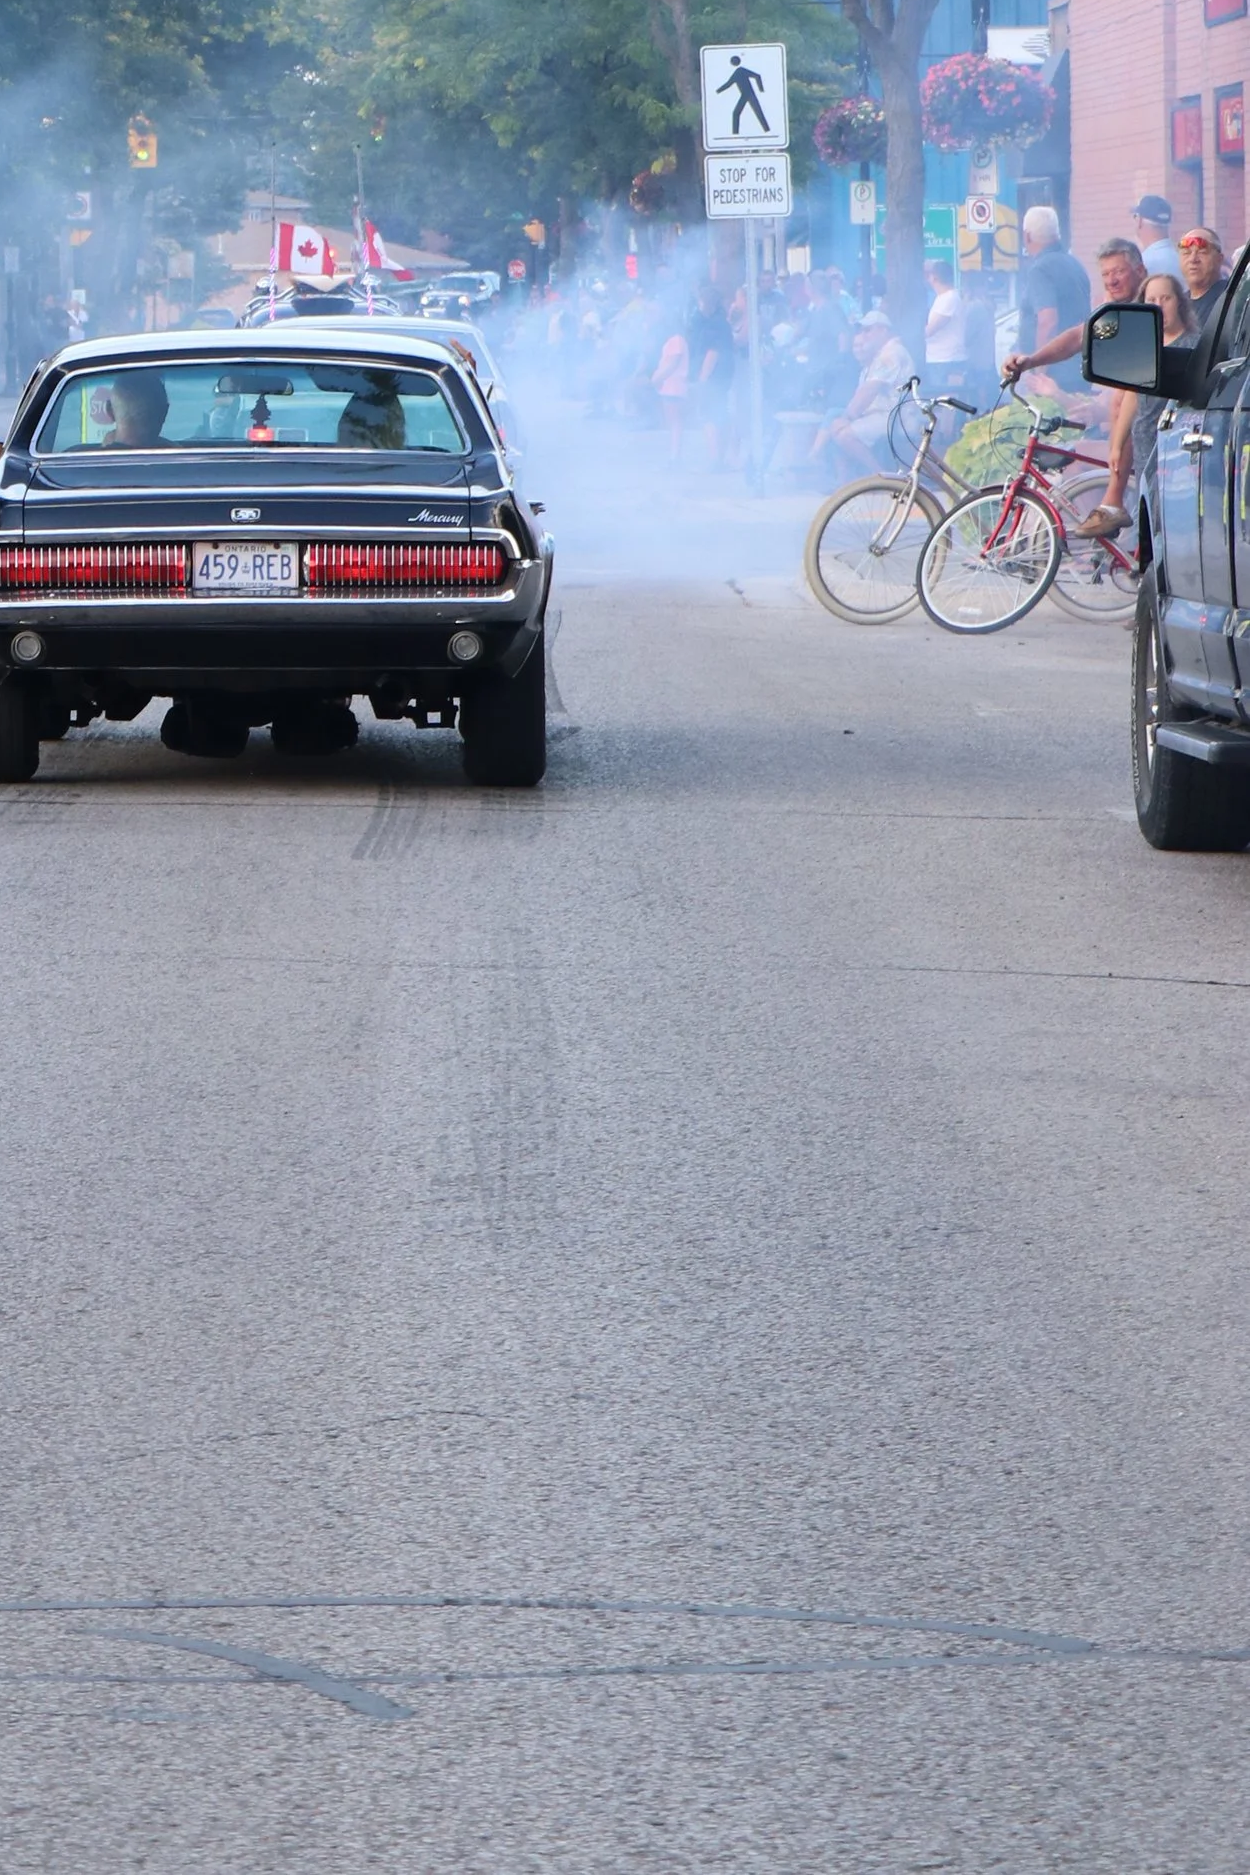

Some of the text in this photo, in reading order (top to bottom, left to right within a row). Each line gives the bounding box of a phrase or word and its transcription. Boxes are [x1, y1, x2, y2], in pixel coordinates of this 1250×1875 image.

[719, 167, 776, 183] STOP FOR
[713, 187, 784, 205] PEDESTRIANS
[408, 508, 464, 527] Mercury
[225, 545, 267, 553] ONTARIO
[199, 554, 292, 580] 459 REB
